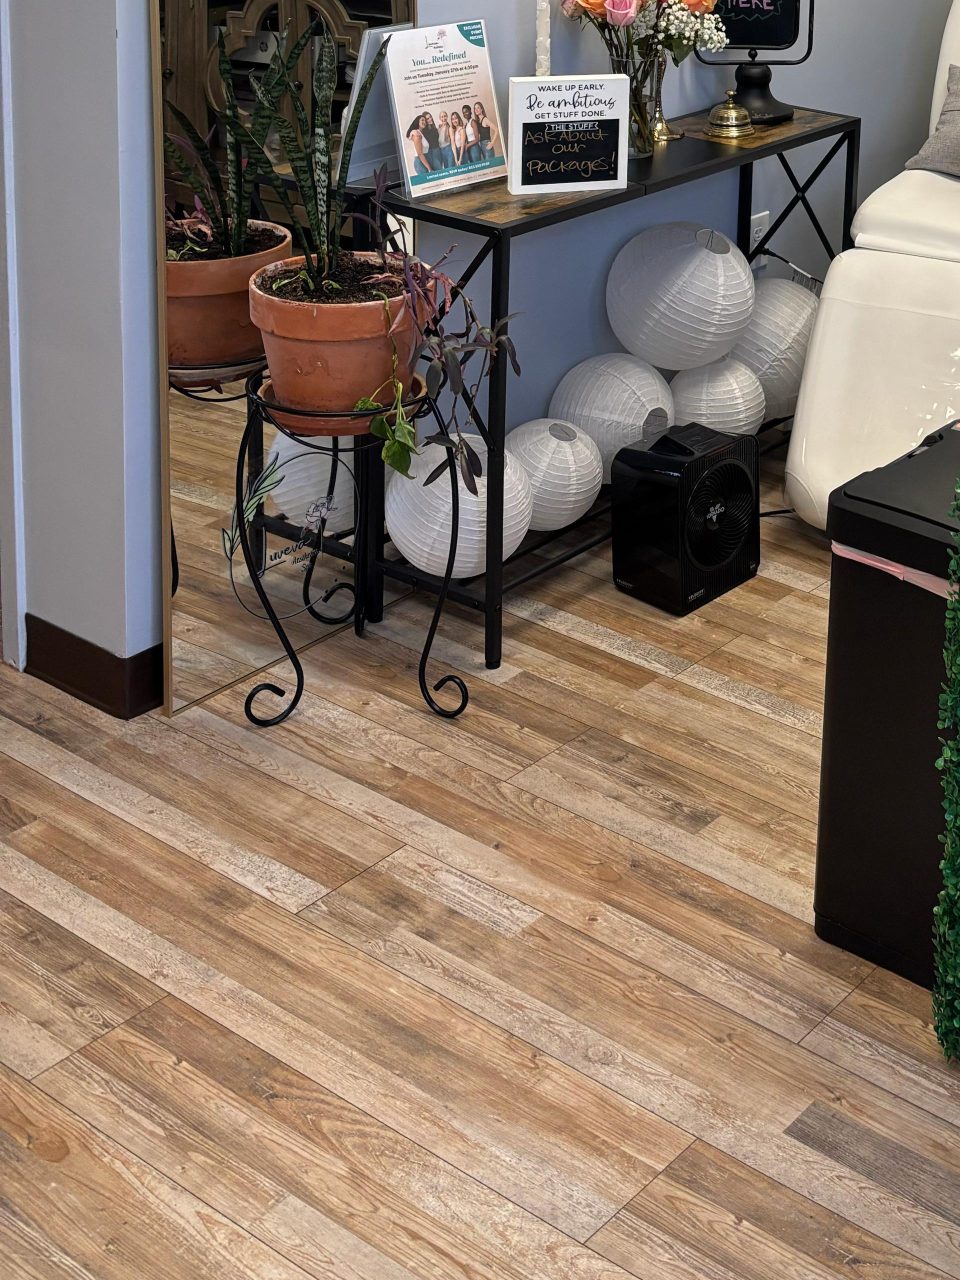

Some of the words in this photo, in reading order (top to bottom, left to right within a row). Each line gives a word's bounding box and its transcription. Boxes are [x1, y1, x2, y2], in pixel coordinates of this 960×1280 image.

[432, 50, 466, 64] Redefined
[526, 94, 544, 111] Be
[548, 91, 616, 109] ambitious
[560, 129, 608, 141] About
[552, 144, 586, 154] our
